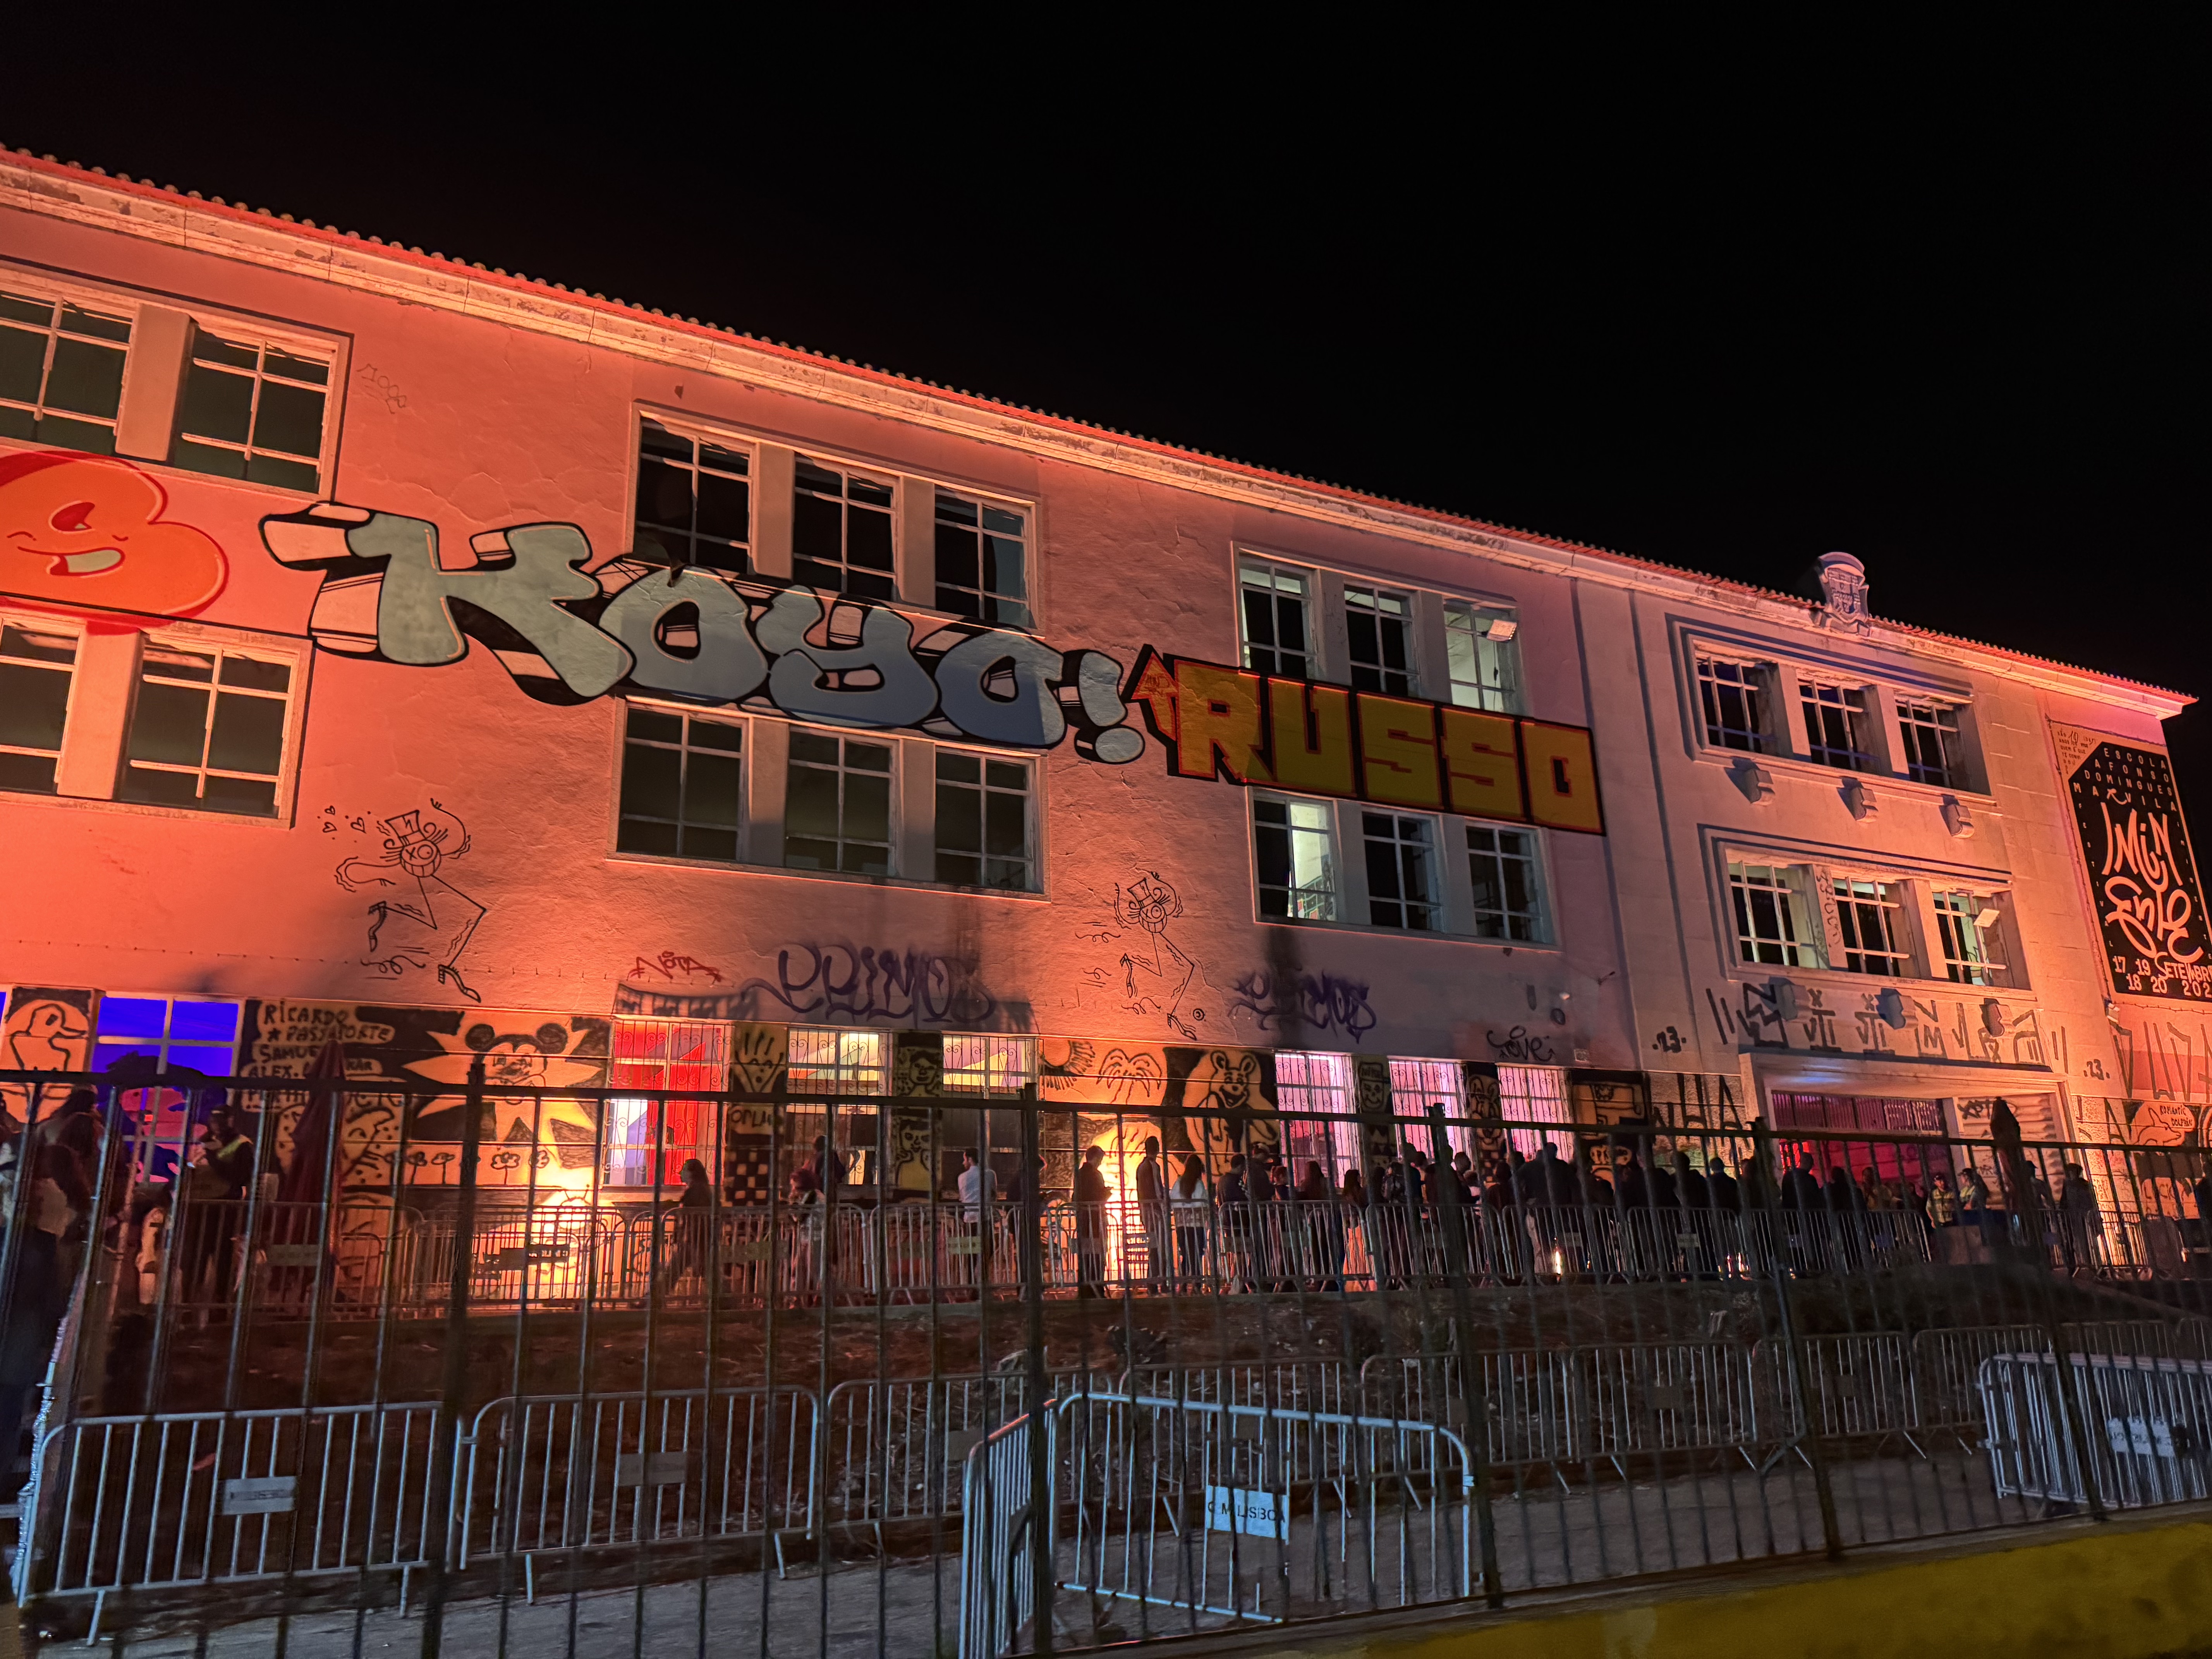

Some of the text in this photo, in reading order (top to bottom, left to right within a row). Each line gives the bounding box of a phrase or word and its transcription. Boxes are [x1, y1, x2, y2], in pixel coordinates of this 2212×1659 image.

[1164, 654, 1606, 836] RUSSO
[2104, 747, 2166, 769] ESCOLA
[2095, 759, 2169, 783] AFONSO
[2084, 770, 2172, 796] DOMINGUES
[2073, 782, 2177, 812] MARVILA
[2112, 955, 2126, 973] 17
[2135, 958, 2151, 976] 19
[2126, 973, 2142, 991] 18
[2150, 976, 2167, 994] 20
[259, 1044, 321, 1063] SAMUE
[1238, 1505, 1285, 1523] LSBO
